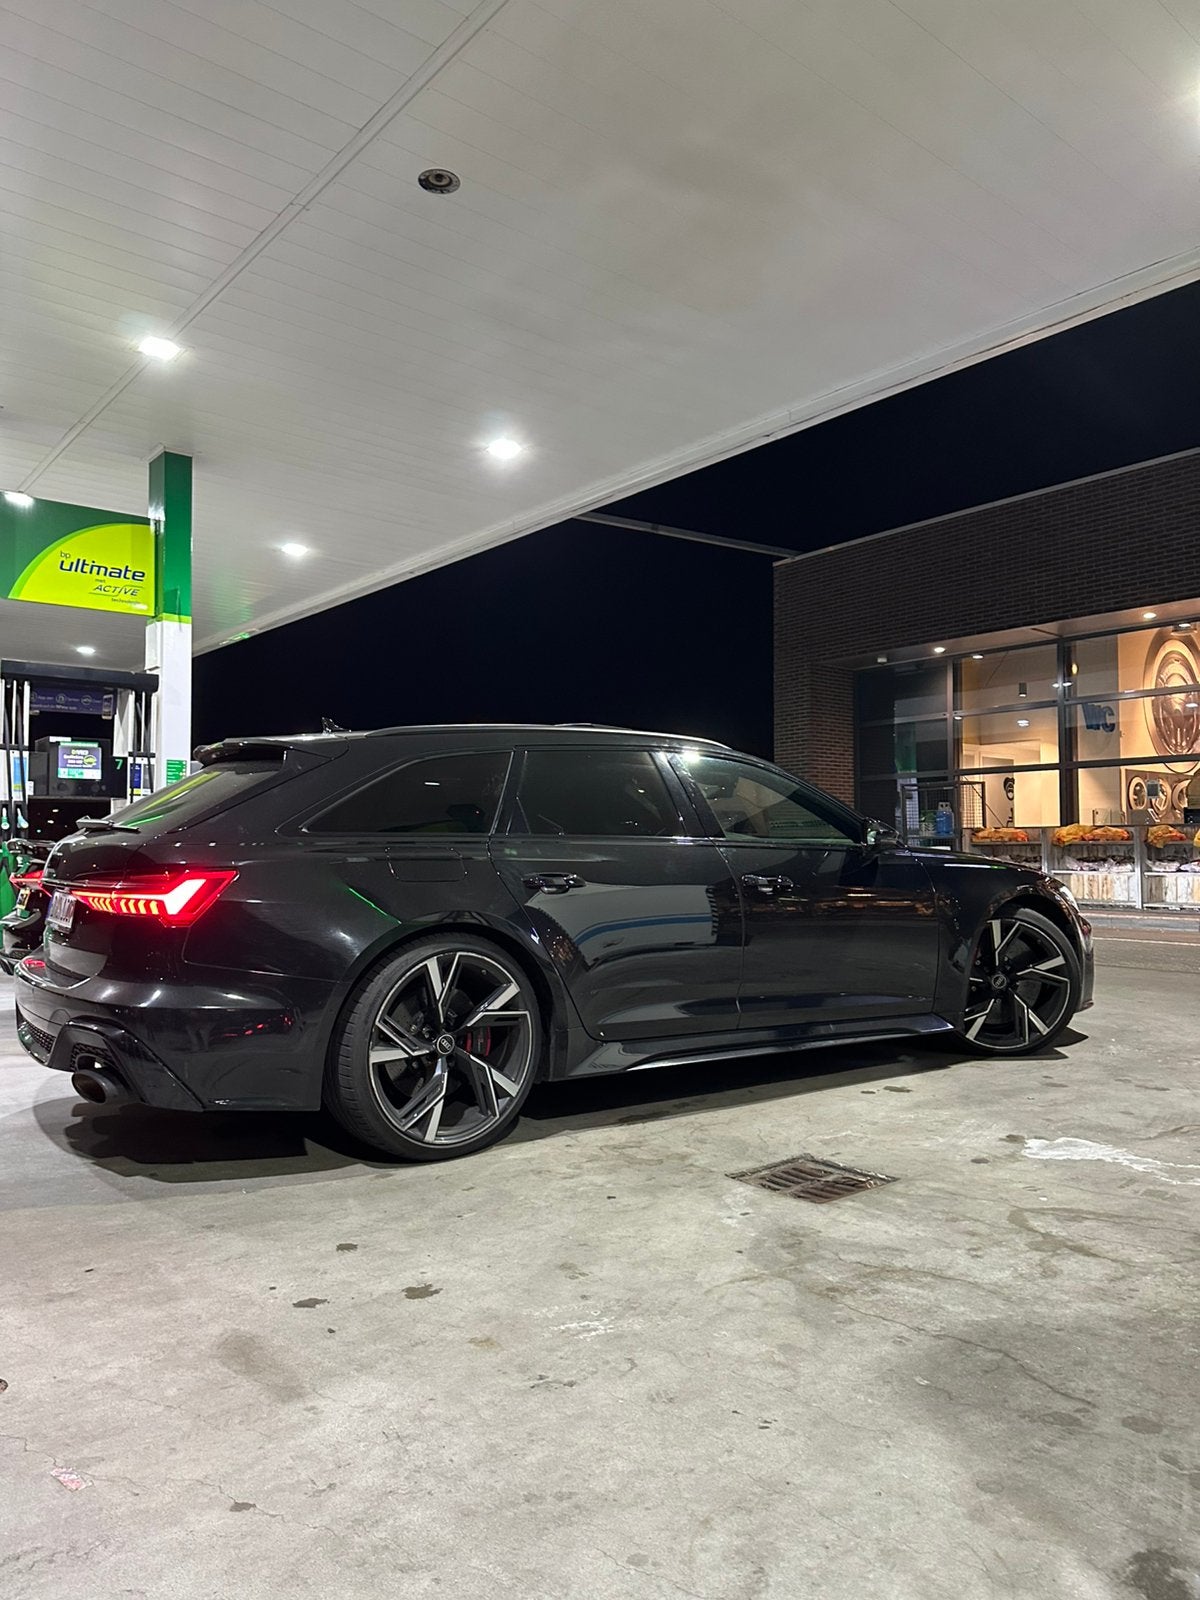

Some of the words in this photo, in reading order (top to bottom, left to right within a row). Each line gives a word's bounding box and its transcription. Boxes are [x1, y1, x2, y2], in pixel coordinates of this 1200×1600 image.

[60, 551, 71, 559] bp
[59, 558, 146, 582] ultimate
[94, 584, 141, 597] ACTIVE
[115, 758, 123, 770] 7
